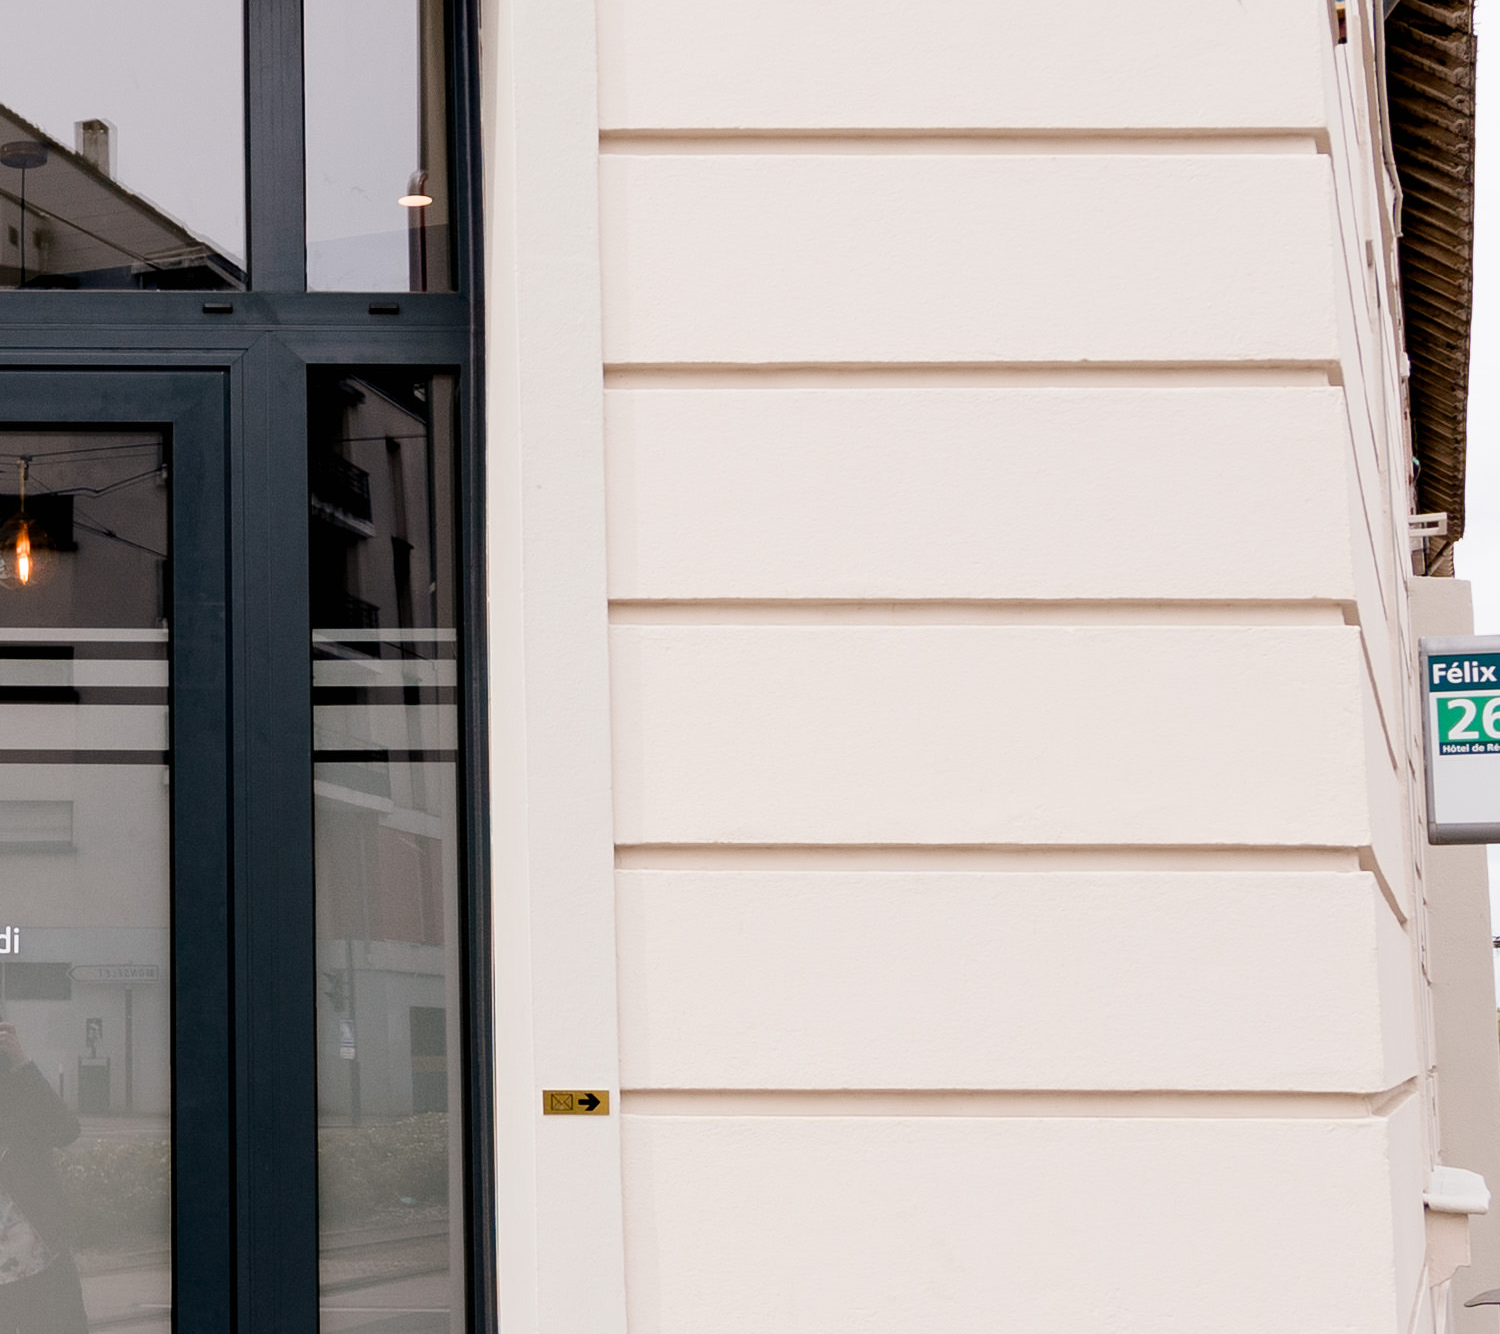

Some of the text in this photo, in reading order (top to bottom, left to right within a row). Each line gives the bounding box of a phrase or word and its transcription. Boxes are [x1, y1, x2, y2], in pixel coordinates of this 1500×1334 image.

[1432, 660, 1497, 685] Félix
[1442, 743, 1470, 753] Hôtel
[1471, 743, 1485, 752] de
